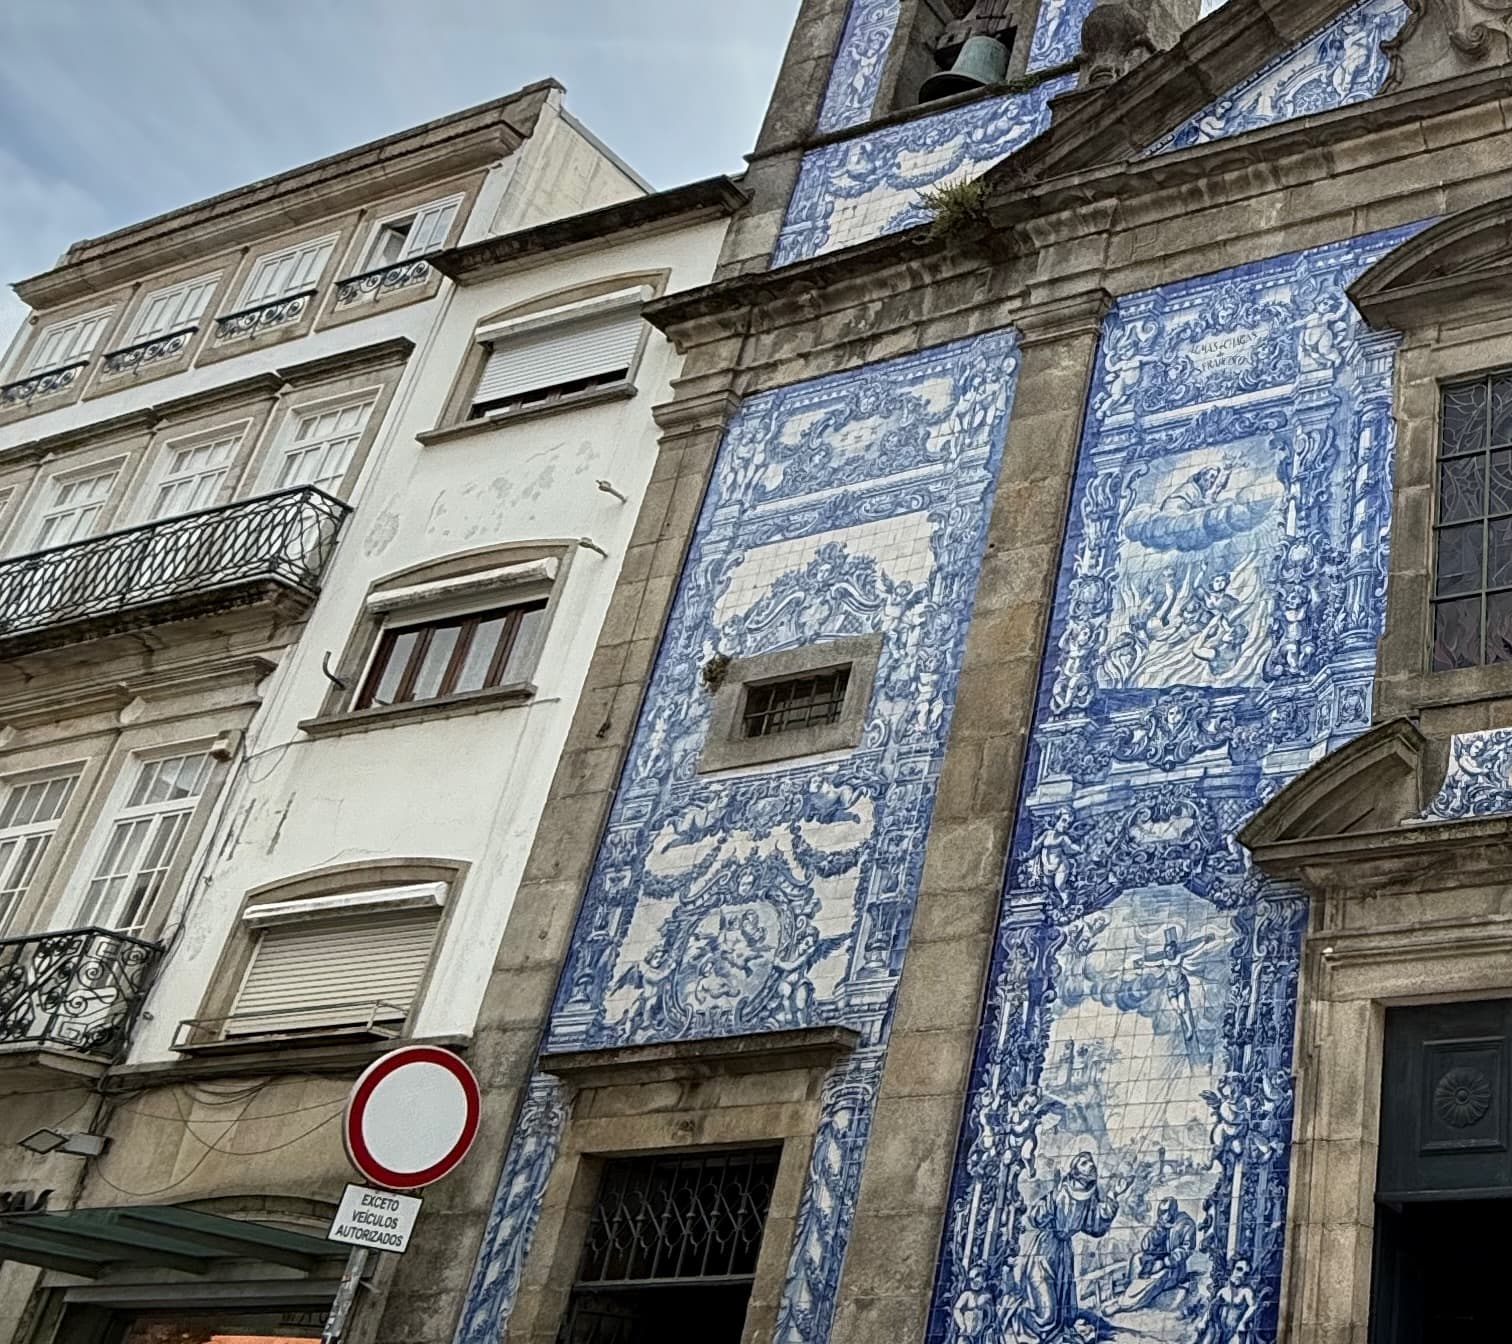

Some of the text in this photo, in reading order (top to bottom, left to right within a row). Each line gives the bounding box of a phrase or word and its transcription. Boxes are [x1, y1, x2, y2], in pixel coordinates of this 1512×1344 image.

[361, 1194, 400, 1212] EXCETO
[351, 1209, 399, 1229] VEÍCULOS
[335, 1224, 404, 1247] AUTORIZADOS
